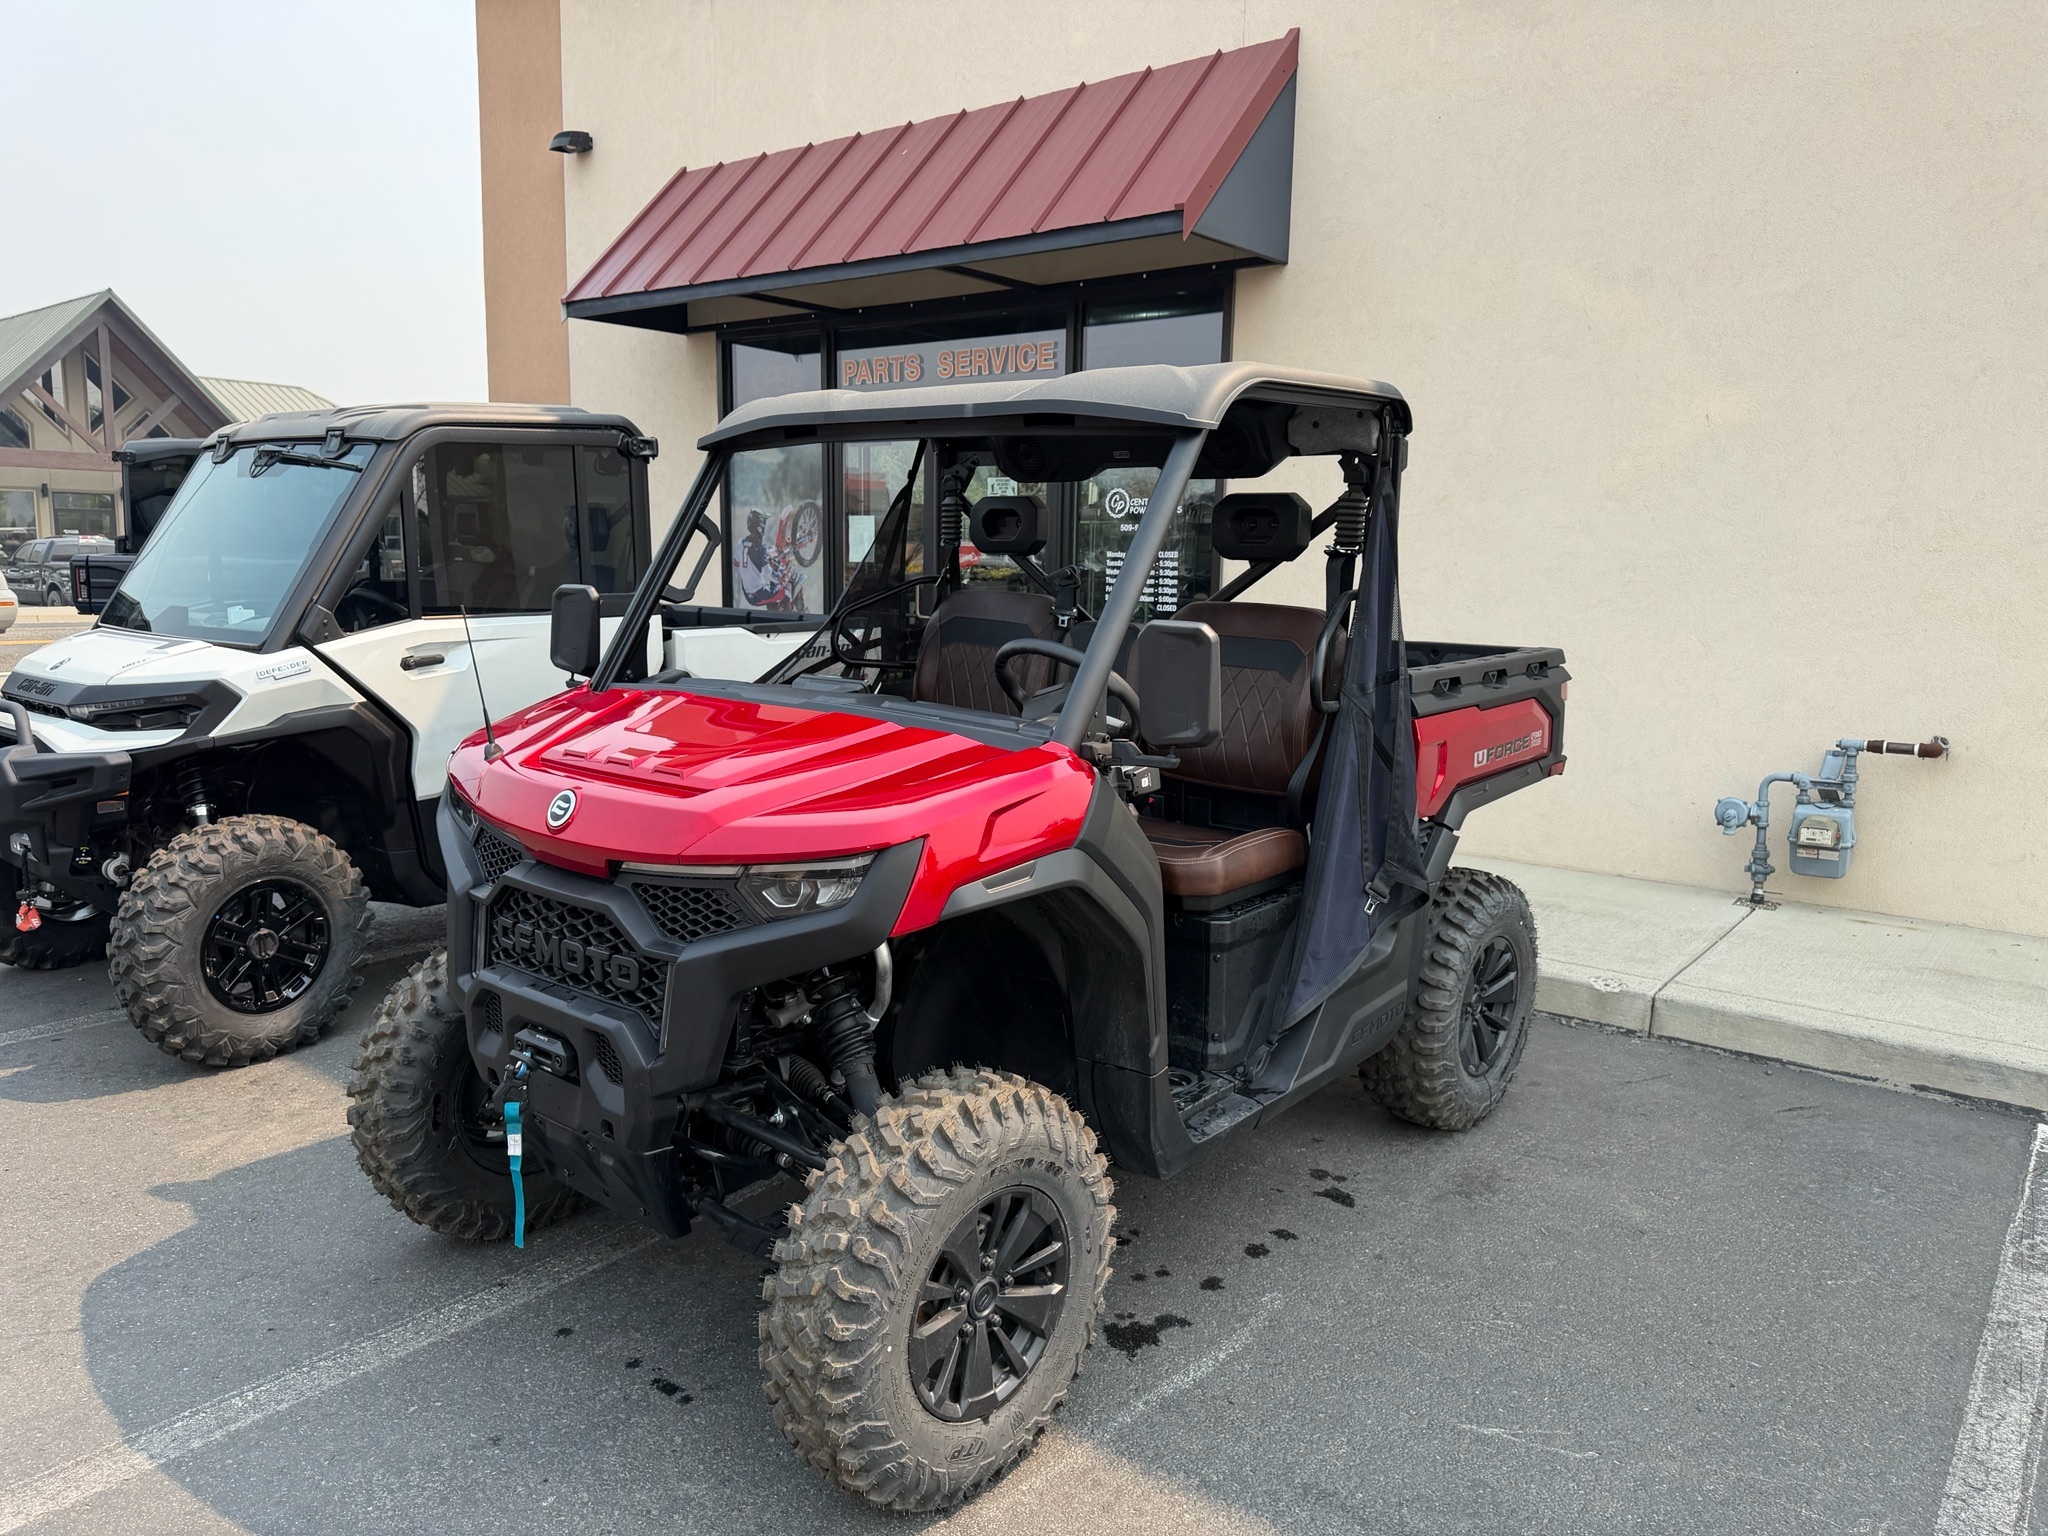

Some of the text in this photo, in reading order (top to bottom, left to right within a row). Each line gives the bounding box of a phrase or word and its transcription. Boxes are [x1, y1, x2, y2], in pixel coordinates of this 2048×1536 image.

[843, 340, 1055, 386] PARTS SERVICE
[1130, 498, 1149, 506] CENT
[1106, 551, 1179, 559] Monday CLOSED
[1106, 559, 1179, 568] Tuesda 5:30pm
[1159, 569, 1179, 577] 5:30pm
[1158, 578, 1178, 586] 5:30pm
[1158, 586, 1178, 594] 5:30pm
[1158, 595, 1178, 604] 5:00pm
[1156, 604, 1177, 612] CLOSED
[259, 660, 308, 677] DEFENDER
[497, 916, 640, 991] CFMOTO
[1351, 1001, 1405, 1047] CFMOTO
[950, 1440, 985, 1462] ITP
